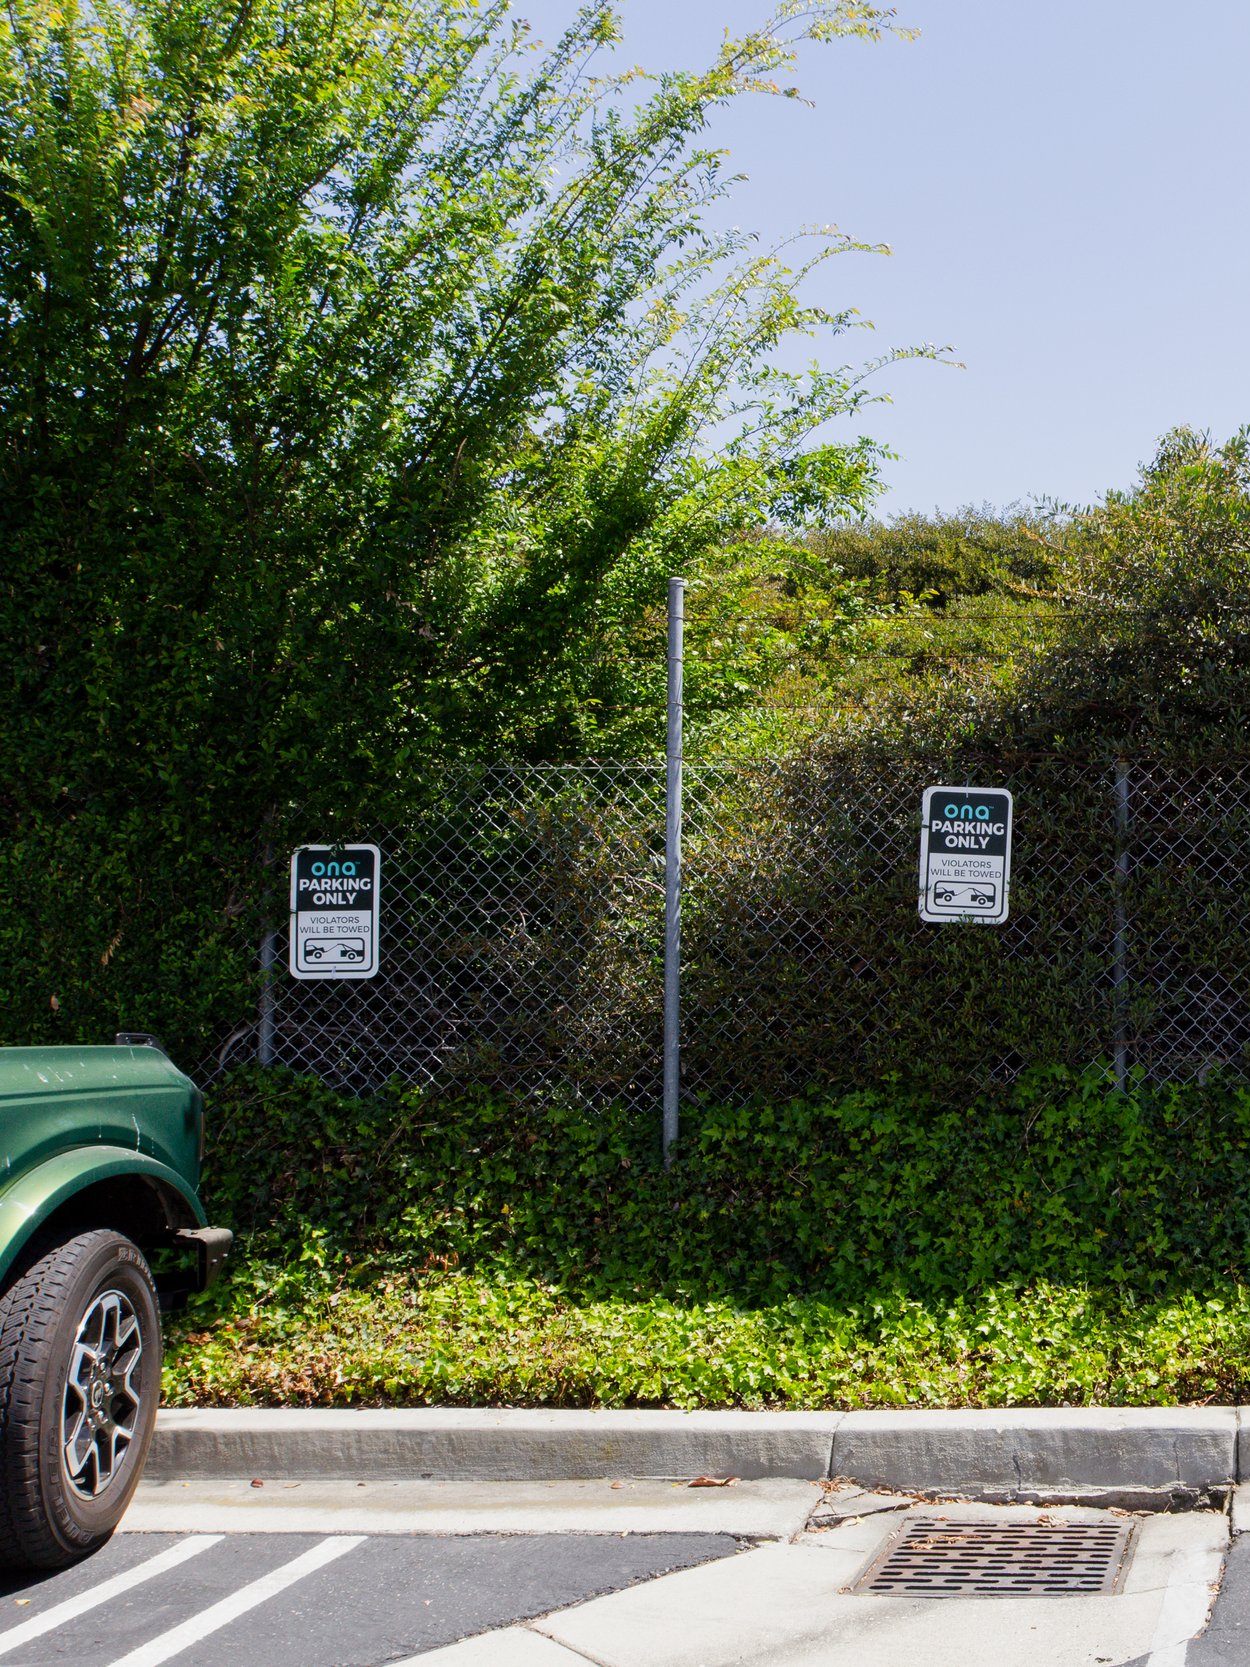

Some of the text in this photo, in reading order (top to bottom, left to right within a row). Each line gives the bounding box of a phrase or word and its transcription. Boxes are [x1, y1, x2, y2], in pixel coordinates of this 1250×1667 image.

[932, 820, 1004, 835] PARKING
[945, 835, 990, 849] ONLY
[942, 859, 991, 868] VIOLATORS
[931, 868, 951, 877] WILL
[968, 870, 1002, 879] TOWED
[299, 878, 371, 891] PARKING
[313, 892, 357, 905] ONLY
[310, 916, 360, 924] VIOLATORS
[300, 926, 320, 934] WILL
[337, 925, 370, 933] TOWED
